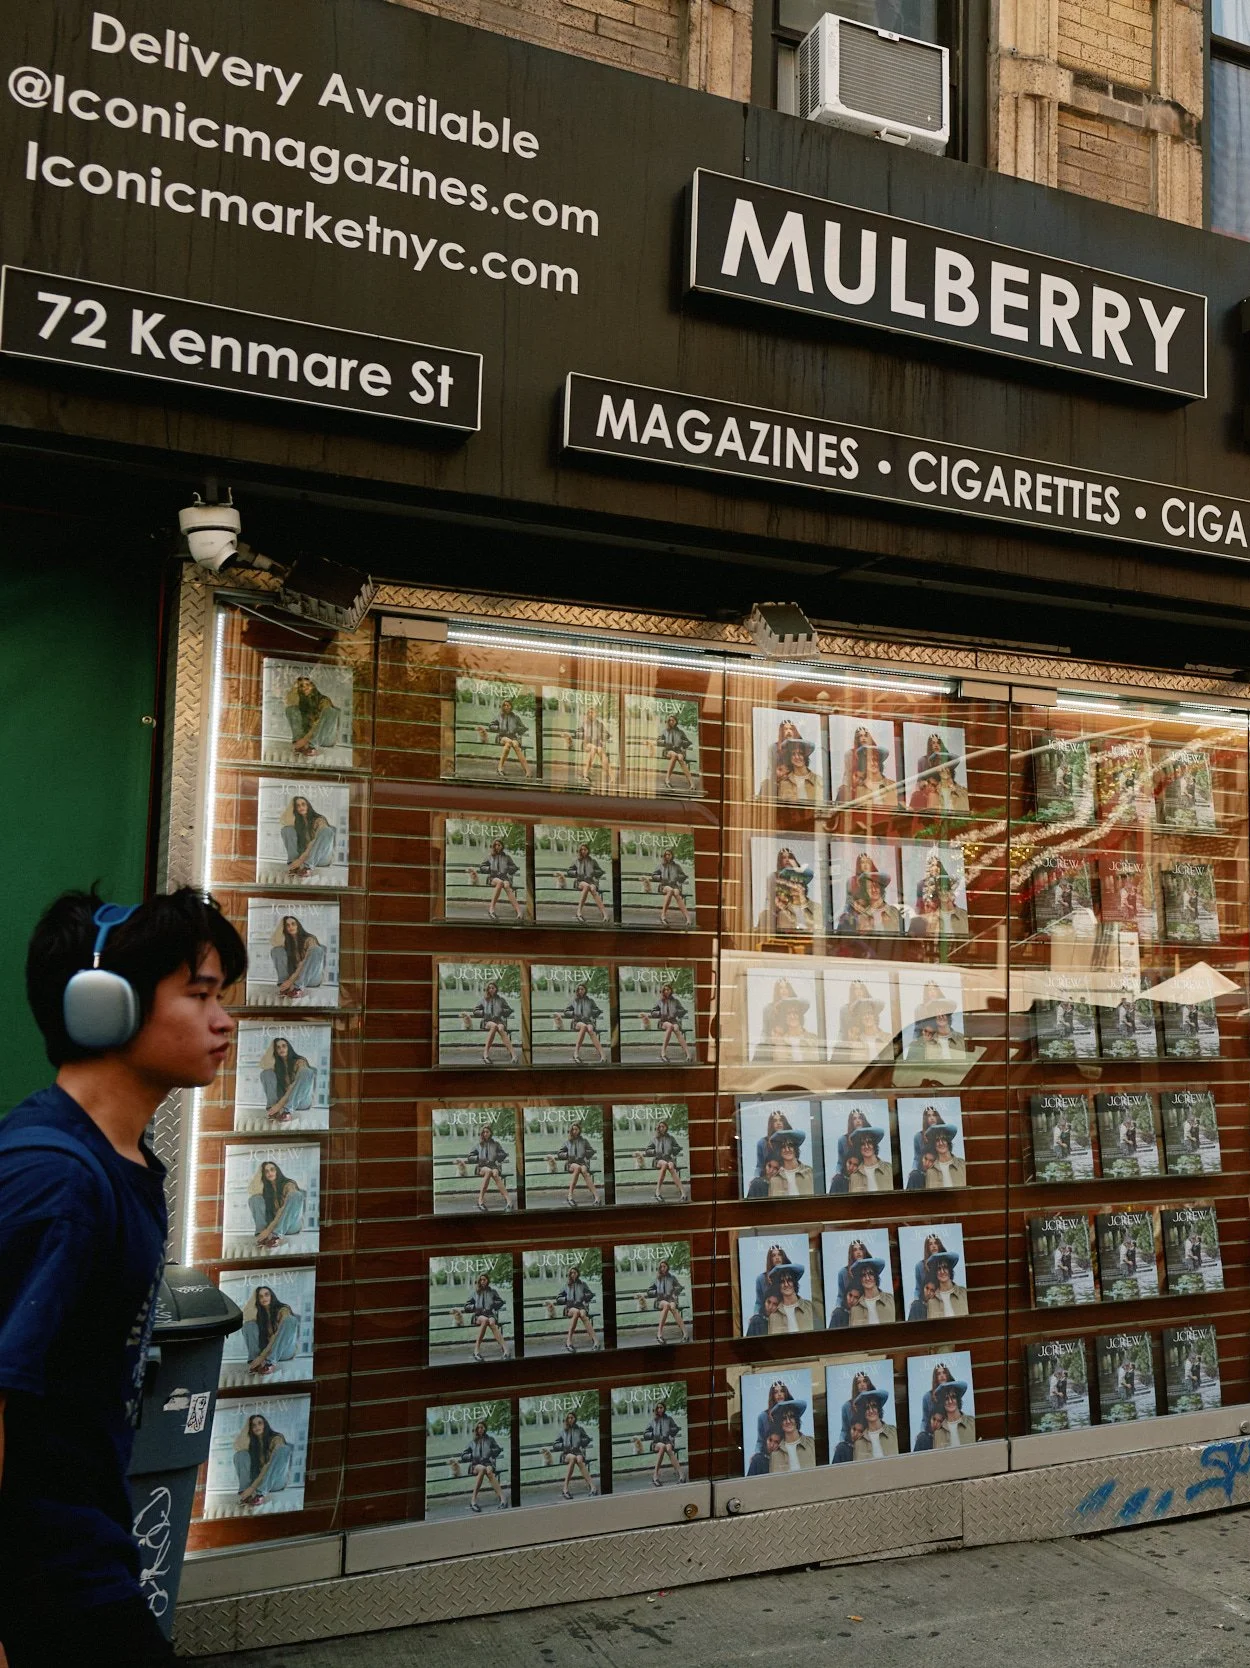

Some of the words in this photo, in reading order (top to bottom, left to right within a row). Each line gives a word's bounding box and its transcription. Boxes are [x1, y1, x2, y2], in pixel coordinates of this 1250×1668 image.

[91, 12, 302, 106] Delivery
[318, 73, 540, 160] Available
[8, 66, 600, 237] @Iconicmagazines.com
[26, 141, 580, 295] Iconicmarketnyc.com
[720, 198, 1186, 373] MULBERRY
[37, 291, 107, 349] 72
[131, 309, 393, 397] Kenmare
[410, 361, 454, 408] St
[596, 394, 860, 479] MAGAZINES
[908, 451, 1120, 525] CIGARETTES
[460, 823, 512, 838] J.CREW
[548, 828, 599, 843] J.CREW
[634, 834, 682, 849] J.CREW
[453, 967, 508, 982] J.CREW
[544, 968, 596, 983] J.CREW
[632, 969, 681, 983] J.CREW
[447, 1111, 502, 1126] J.CREW
[538, 1108, 590, 1123] J.CREW
[625, 1106, 676, 1121] J.CREW
[536, 1251, 588, 1267] J.CREW
[628, 1246, 678, 1261] J.CREW
[444, 1257, 499, 1274] J.CREW
[624, 1386, 674, 1403] J.CREW
[533, 1395, 586, 1414] J.CREW
[441, 1404, 497, 1424] J.CREW
